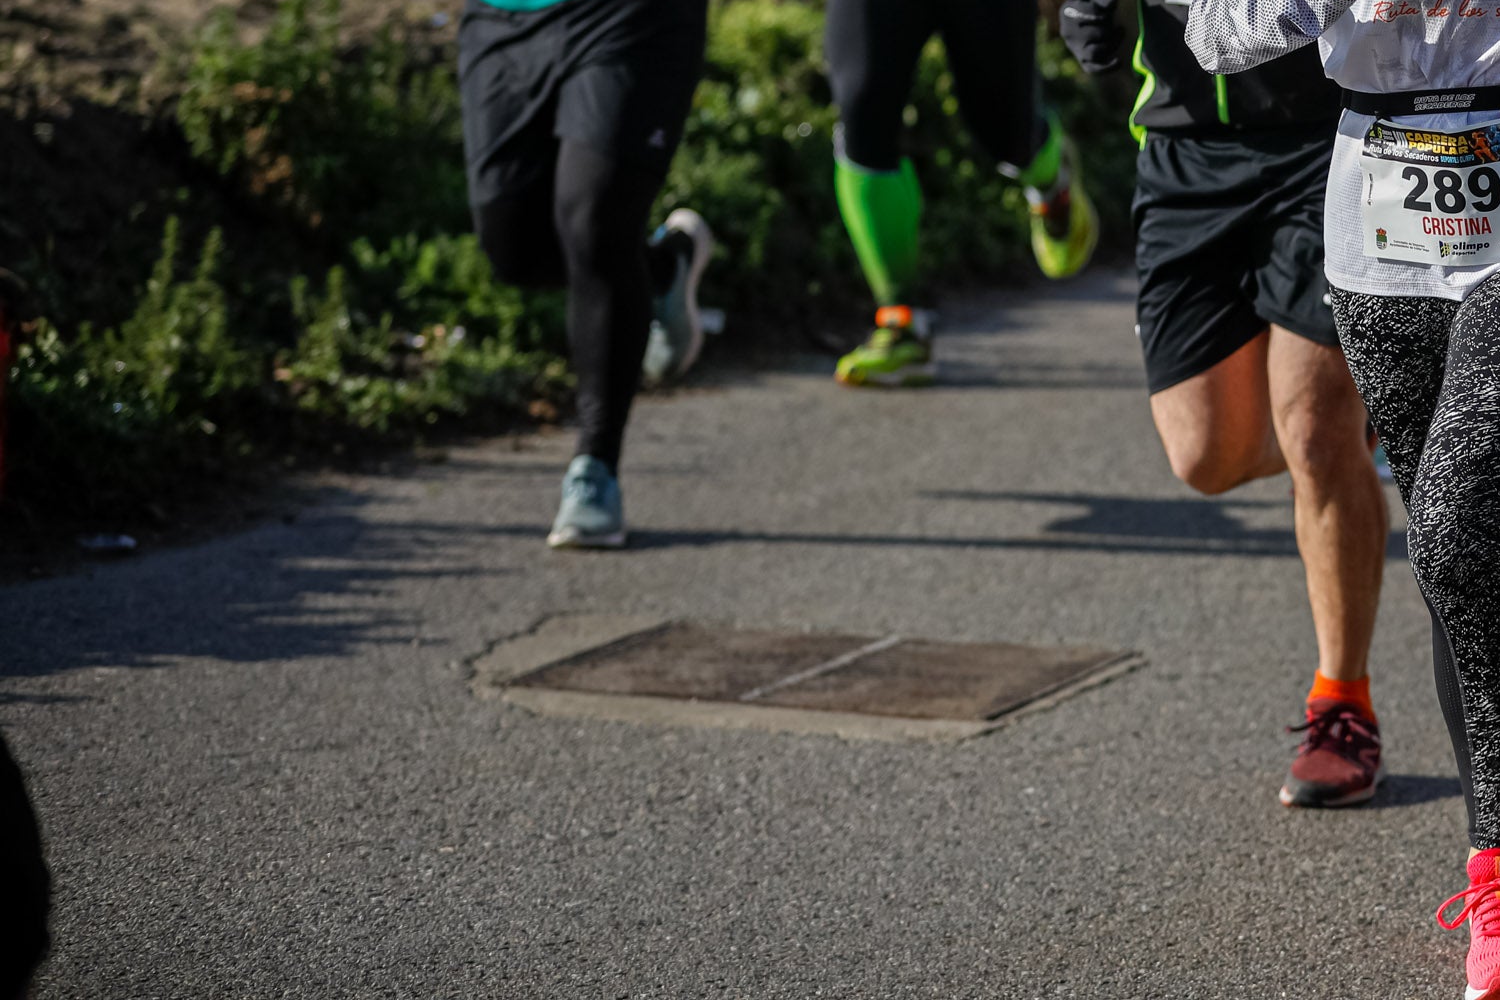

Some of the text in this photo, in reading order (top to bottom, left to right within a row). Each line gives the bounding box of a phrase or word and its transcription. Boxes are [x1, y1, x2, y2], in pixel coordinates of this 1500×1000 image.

[1373, 1, 1420, 24] Ruta
[1414, 95, 1440, 104] RUTA
[1455, 93, 1476, 101] LOS
[1414, 101, 1472, 111] SECADEROS
[1405, 132, 1468, 146] CARRERA
[1368, 143, 1383, 154] Ruta
[1383, 147, 1392, 155] de
[1392, 149, 1403, 157] los
[1404, 150, 1439, 162] Secaderos
[1408, 141, 1469, 156] POPULAR
[1422, 216, 1492, 236] CRISTINA
[1453, 241, 1490, 252] olimpo
